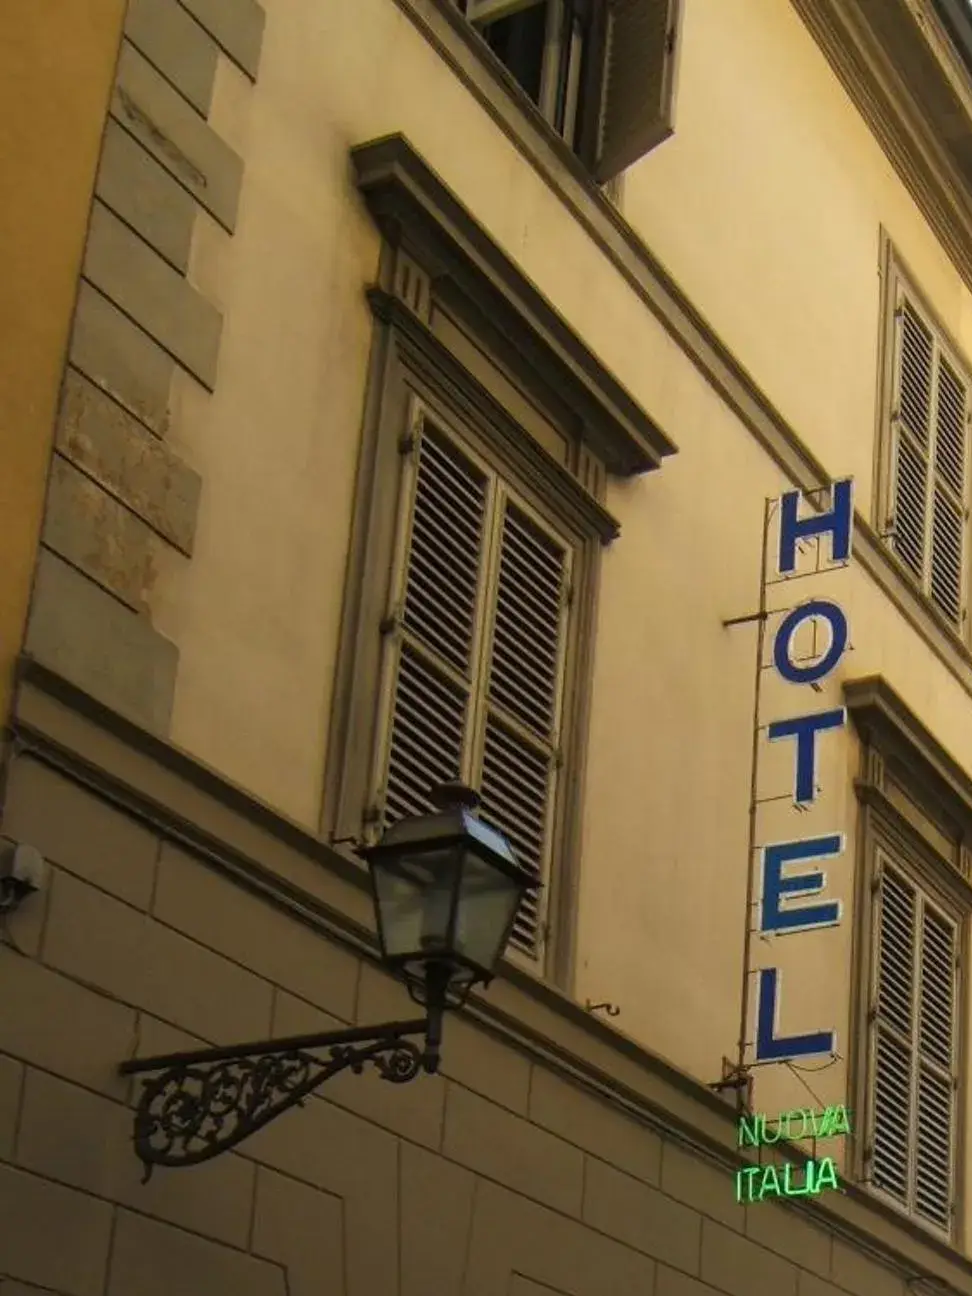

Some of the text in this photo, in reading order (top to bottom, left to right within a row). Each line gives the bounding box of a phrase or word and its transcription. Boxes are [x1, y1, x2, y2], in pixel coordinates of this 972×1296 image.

[754, 477, 854, 1061] HOTEL
[738, 1103, 851, 1147] NUOVA
[736, 1156, 839, 1203] ITALIA
